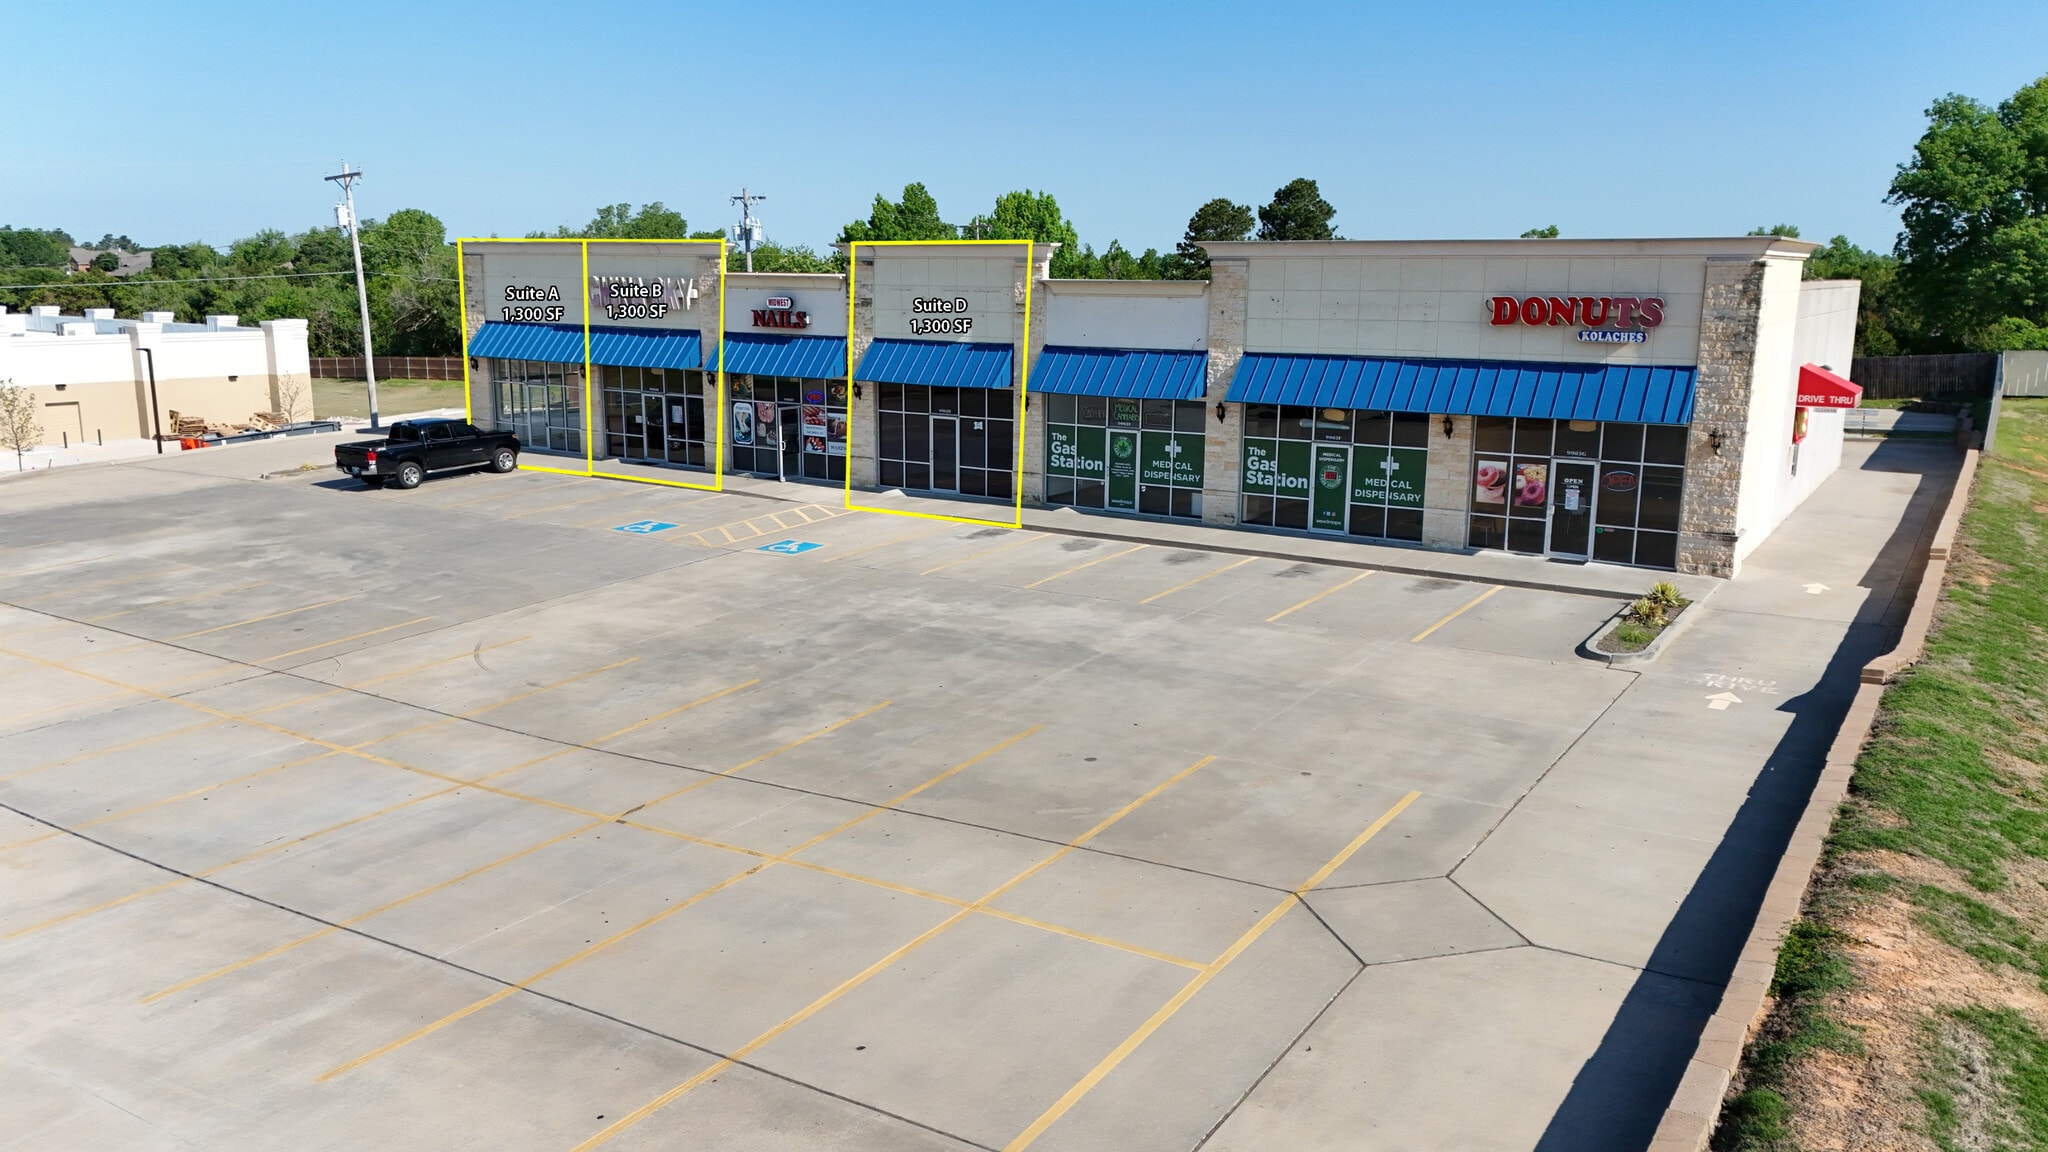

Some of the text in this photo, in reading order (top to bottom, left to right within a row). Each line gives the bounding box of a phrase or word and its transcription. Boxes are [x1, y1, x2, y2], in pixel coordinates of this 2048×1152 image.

[767, 298, 790, 308] MIDWEST
[1490, 296, 1666, 328] DONUTS
[751, 309, 807, 329] NAILS
[1581, 331, 1645, 343] KOLACHES
[1798, 394, 1854, 404] DRIVE THRU
[1051, 432, 1067, 441] The
[1051, 441, 1076, 455] Gas
[1247, 446, 1266, 456] The
[1050, 455, 1103, 471] Station
[1247, 456, 1276, 471] Gas
[1246, 470, 1308, 489] Station
[1601, 475, 1639, 488] OPEN
[1703, 673, 1776, 685] THRU
